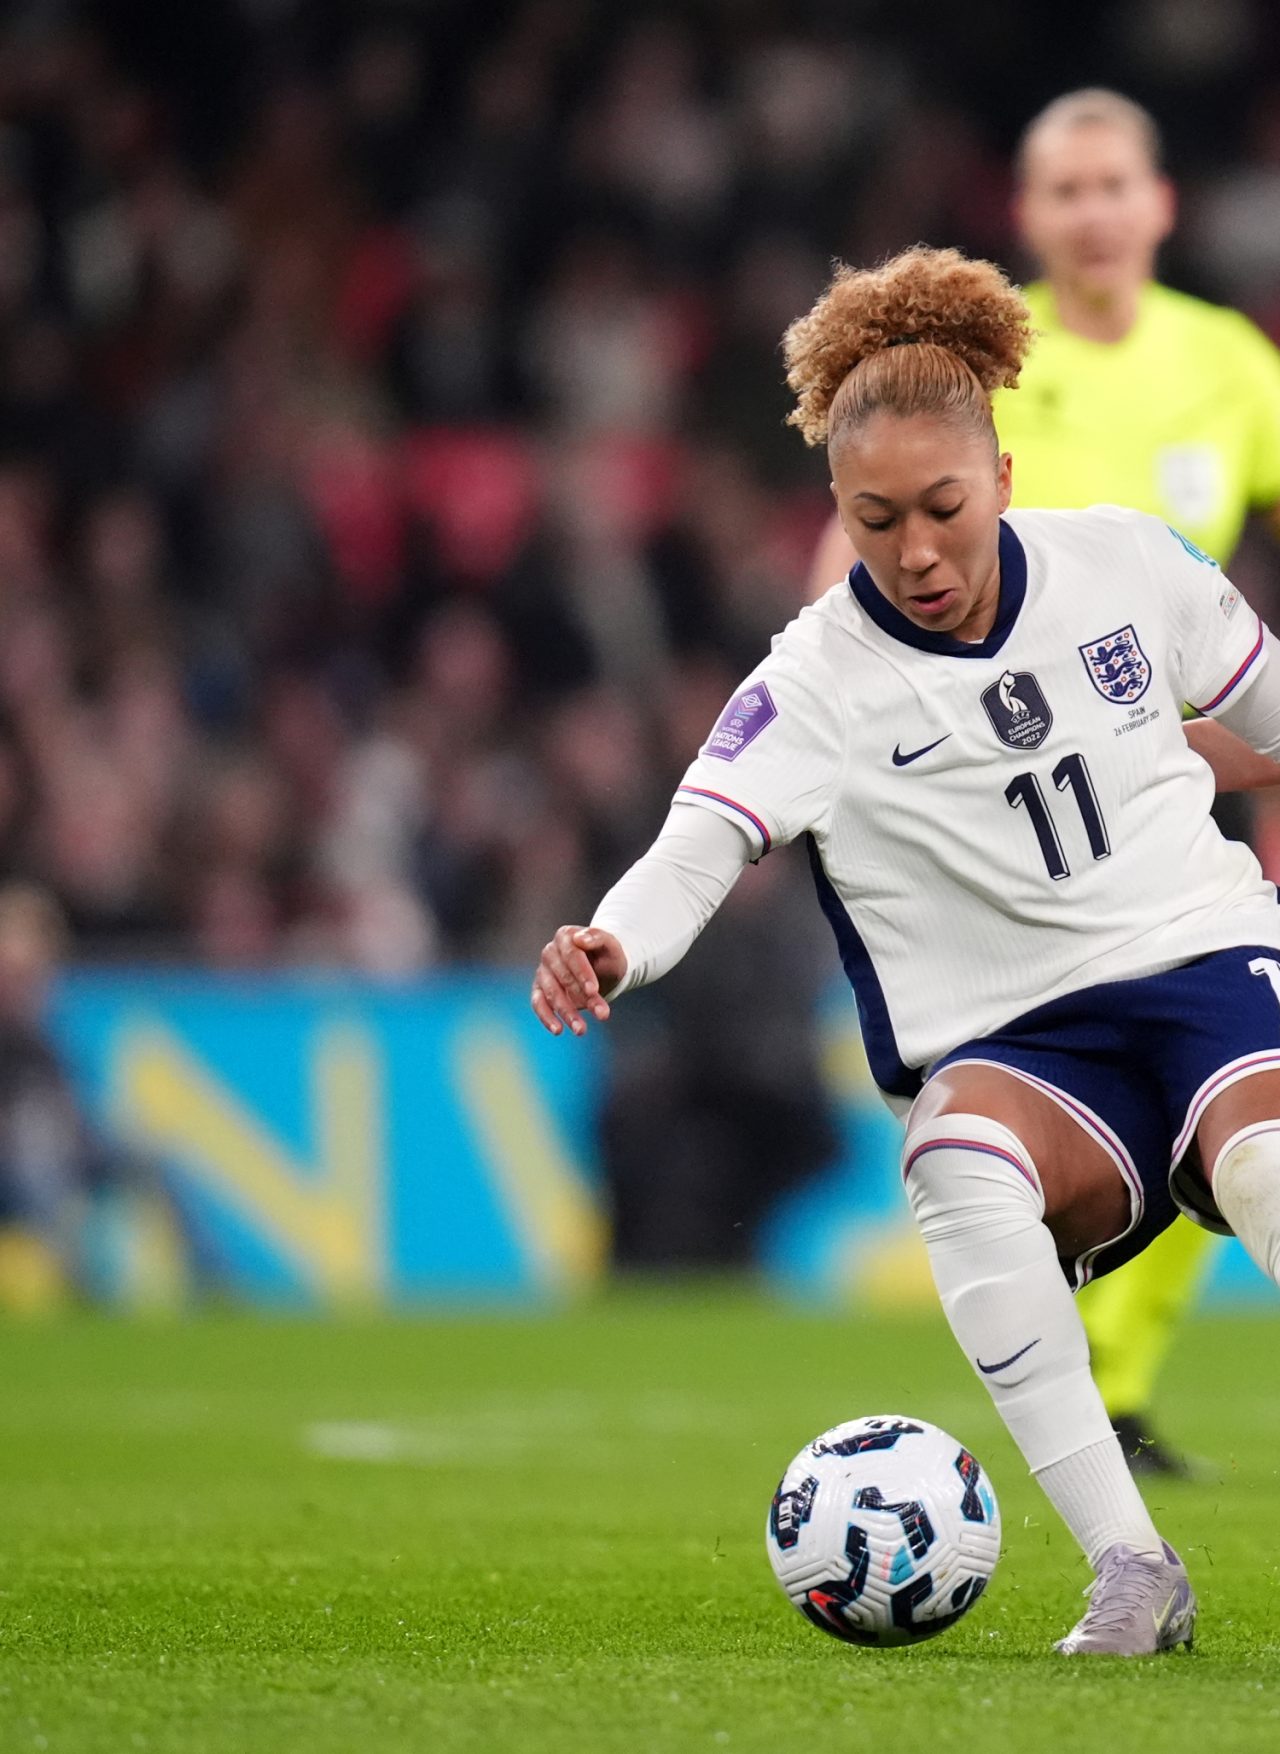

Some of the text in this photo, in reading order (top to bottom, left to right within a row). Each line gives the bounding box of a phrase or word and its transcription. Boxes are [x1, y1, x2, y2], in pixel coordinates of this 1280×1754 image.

[1128, 706, 1146, 719] SPAIN
[1007, 715, 1042, 736] EUROPEAN
[1009, 720, 1046, 742] CHAMPIONS
[1121, 715, 1149, 734] FEBRUARY
[711, 738, 738, 752] LEAGUE
[714, 731, 745, 746] NATIONS
[1022, 732, 1042, 746] 2022
[1004, 753, 1111, 881] 11
